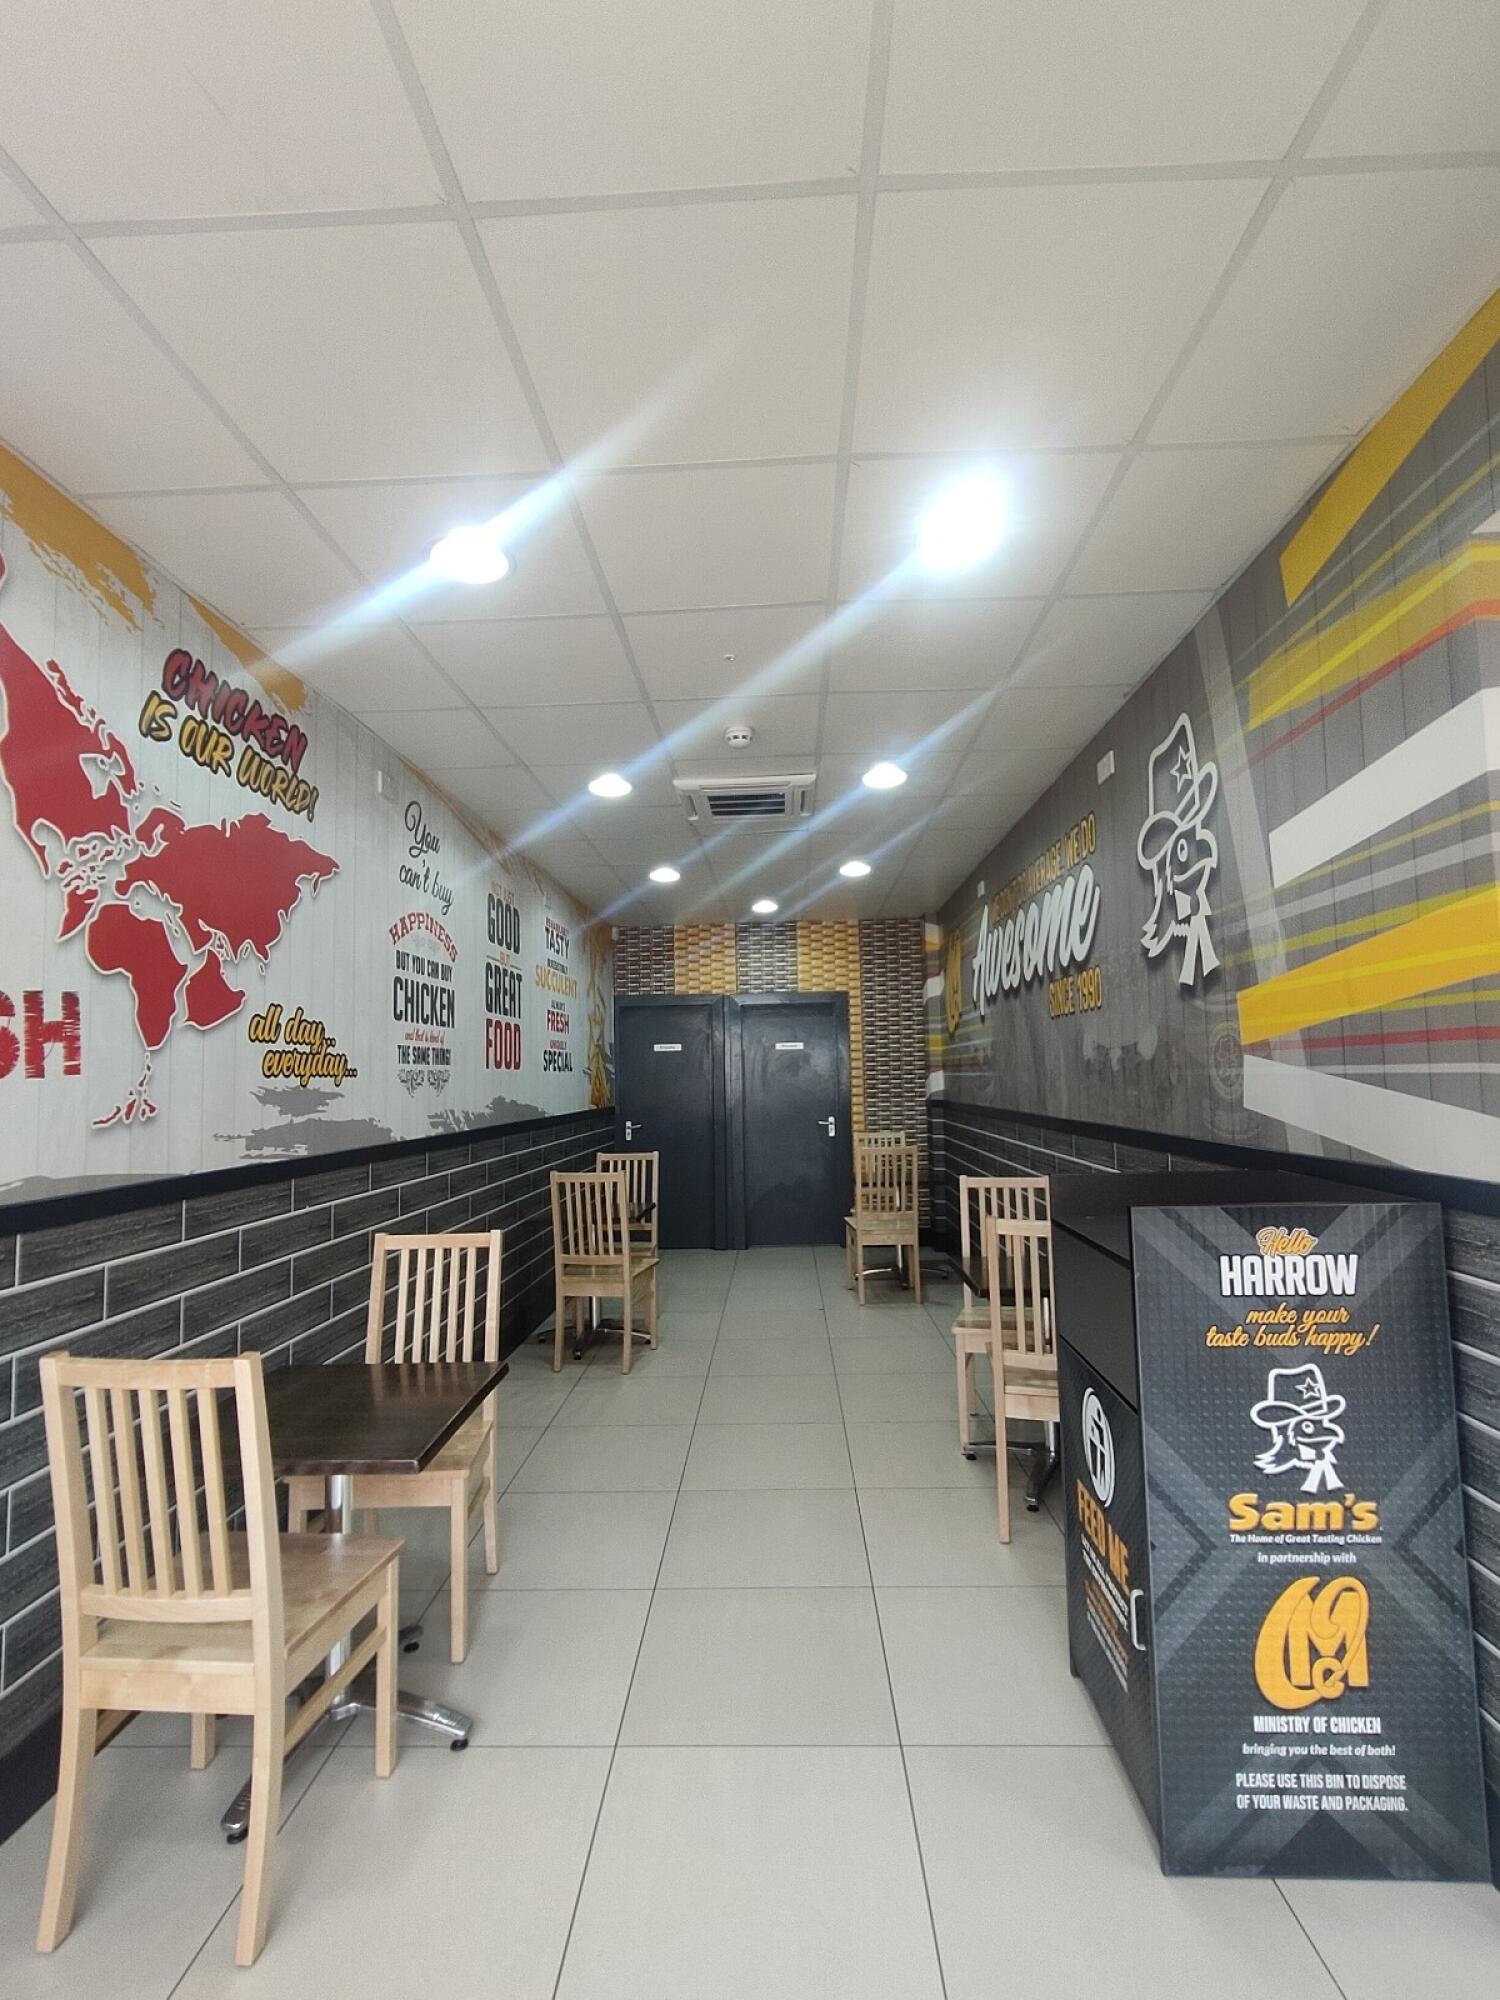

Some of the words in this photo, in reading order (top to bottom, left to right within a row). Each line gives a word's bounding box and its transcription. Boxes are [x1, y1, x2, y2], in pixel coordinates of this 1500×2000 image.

[162, 648, 308, 775] CHICKEN
[139, 690, 177, 742] IS
[179, 715, 235, 778] OUR
[236, 745, 319, 823] WORLD!
[405, 801, 440, 858] You
[1080, 810, 1096, 860] DO
[400, 859, 430, 893] can't
[431, 871, 454, 915] buy
[389, 912, 458, 963] HAPPINESS
[487, 893, 520, 955] GOOD
[544, 925, 570, 960] TASTY
[972, 864, 1100, 1016] Awesome
[396, 950, 410, 971] BUT
[412, 954, 425, 975] YOU
[427, 960, 439, 979] CAN
[440, 964, 452, 983] BUY
[536, 964, 577, 1000] SUCCULENT
[393, 976, 455, 1029] CHICKEN
[485, 962, 522, 1019] GREAT
[1050, 975, 1075, 1018] SINCE
[1077, 967, 1102, 1013] 1990
[249, 1003, 283, 1044] all
[547, 1009, 569, 1035] FRESH
[397, 1045, 410, 1065] THE
[412, 1046, 430, 1065] SAME
[485, 1018, 521, 1070] FOOD
[543, 1049, 573, 1072] SPECIAL
[1256, 1226, 1318, 1258] Hello
[1219, 1254, 1359, 1297] HARROW
[1246, 1302, 1297, 1324] make
[1297, 1306, 1350, 1333] your
[1205, 1325, 1249, 1347] taste
[1253, 1324, 1300, 1347] buds
[1305, 1324, 1380, 1355] happy!
[1228, 1493, 1379, 1531] Sam's
[1077, 1479, 1105, 1557] FEED
[1108, 1522, 1131, 1597] ME
[1230, 1534, 1246, 1544] The
[1246, 1534, 1273, 1544] Home
[1274, 1534, 1284, 1545] of
[1285, 1534, 1310, 1544] Great
[1312, 1534, 1345, 1546] Tasting
[1346, 1534, 1382, 1544] Chicken
[1257, 1552, 1268, 1563] in
[1270, 1552, 1331, 1566] partnership
[1333, 1552, 1357, 1563] with
[1253, 1716, 1310, 1733] MINISTRY
[1313, 1716, 1328, 1733] OF
[1330, 1716, 1381, 1734] CHICKEN
[1242, 1743, 1287, 1757] bringing
[1288, 1746, 1308, 1757] you
[1310, 1744, 1327, 1755] the
[1329, 1744, 1353, 1755] best
[1354, 1744, 1368, 1757] of
[1367, 1745, 1396, 1756] both!
[1235, 1773, 1275, 1788] PLEASE
[1277, 1774, 1298, 1788] USE
[1299, 1774, 1324, 1789] THIS
[1326, 1774, 1344, 1789] BIN
[1346, 1775, 1360, 1789] TO
[1362, 1775, 1407, 1790] DISPOSE
[1236, 1794, 1250, 1809] OF
[1252, 1794, 1281, 1809] YOUR
[1282, 1795, 1319, 1810] WASTE
[1321, 1795, 1344, 1810] AND
[1345, 1796, 1409, 1811] PACKAGING.
